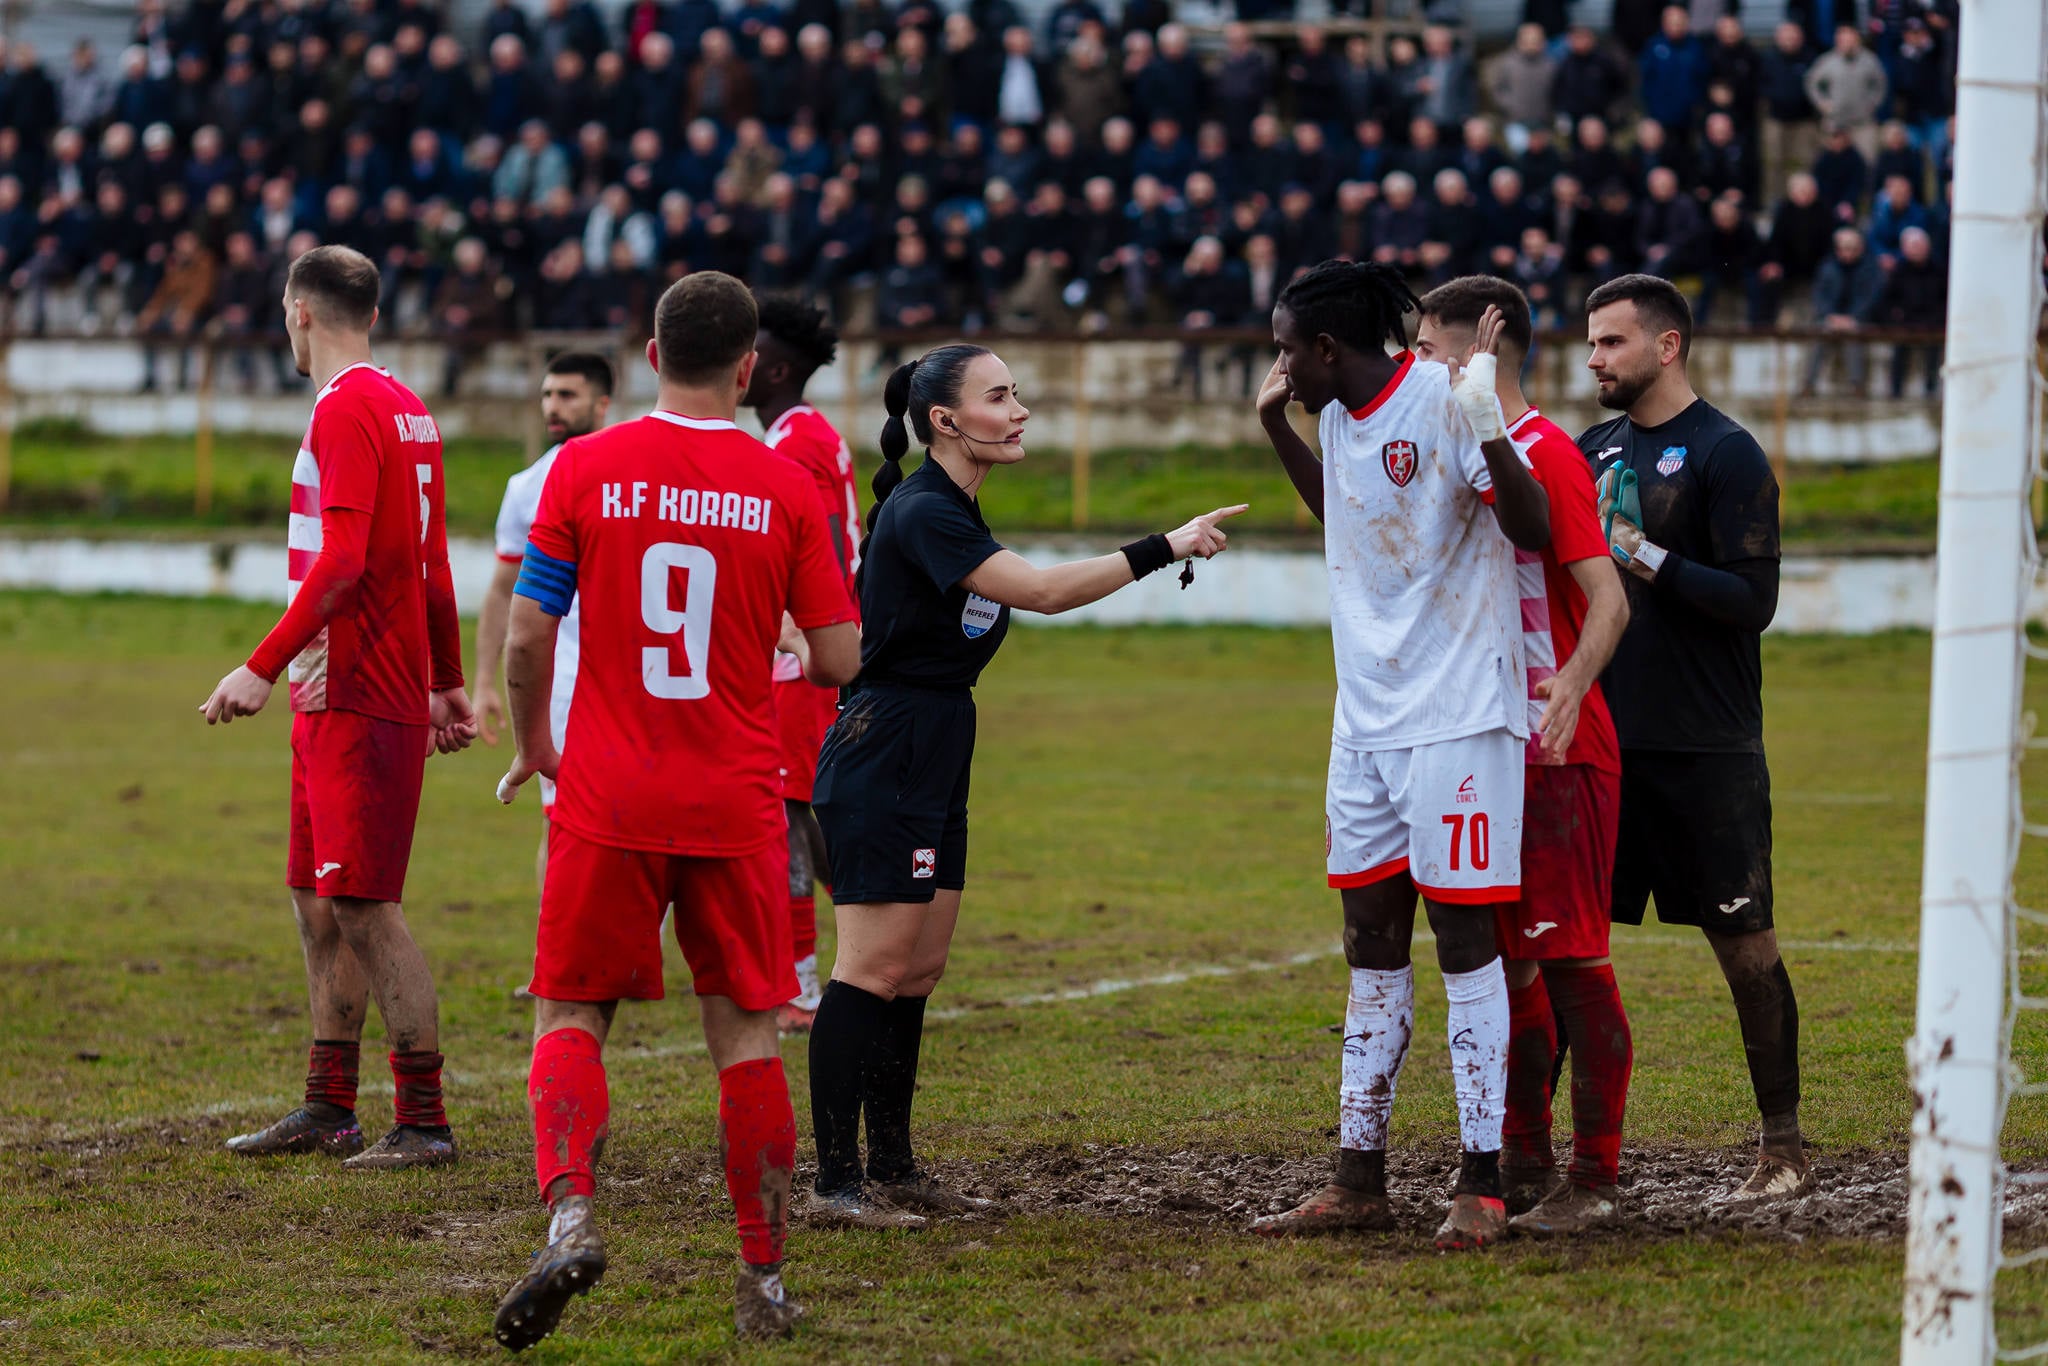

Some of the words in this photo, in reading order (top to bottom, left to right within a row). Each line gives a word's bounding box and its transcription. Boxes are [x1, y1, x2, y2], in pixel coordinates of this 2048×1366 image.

[415, 463, 433, 580] 5
[602, 481, 649, 518] K.F
[658, 484, 772, 535] KORABI
[640, 541, 718, 700] 9
[967, 608, 995, 620] REFEREE
[1441, 812, 1489, 871] 70
